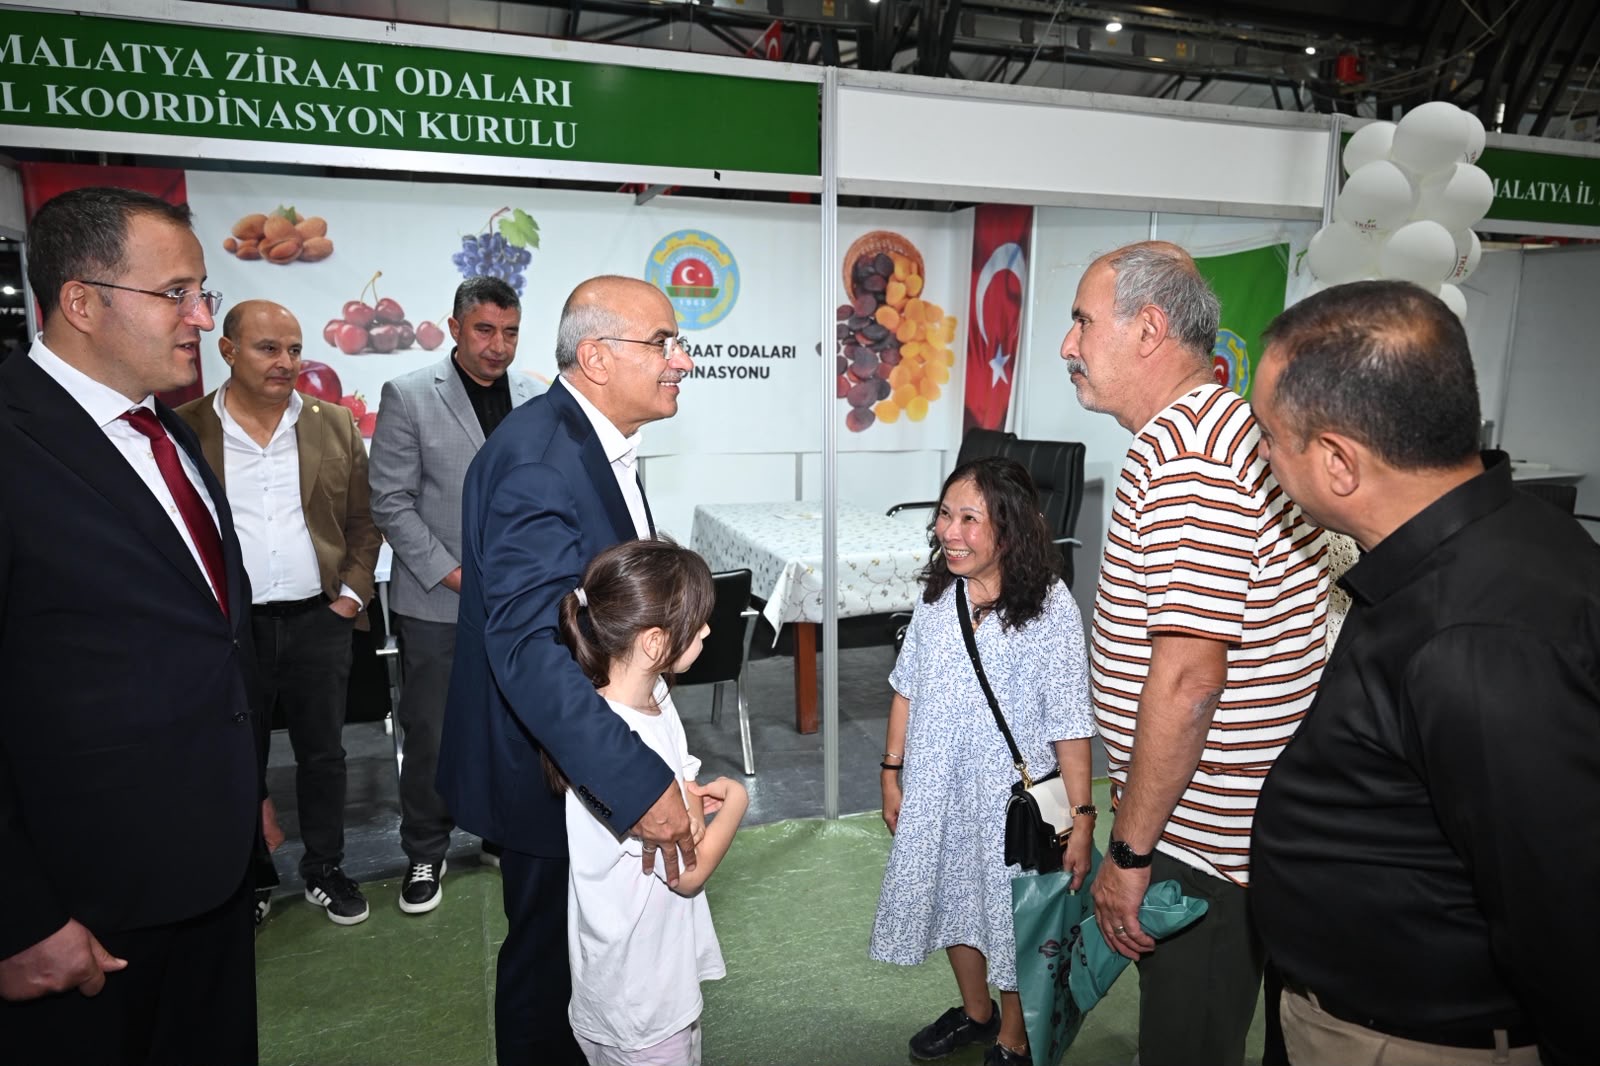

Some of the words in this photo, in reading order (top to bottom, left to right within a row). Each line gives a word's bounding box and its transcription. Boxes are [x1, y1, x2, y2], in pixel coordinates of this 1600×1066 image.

[0, 34, 214, 79] MALATYA
[226, 46, 383, 93] ZİRAAT
[395, 66, 573, 108] ODALARI
[42, 83, 405, 137] KOORDİNASYON
[417, 111, 579, 148] KURULU
[1576, 181, 1595, 206] İL
[727, 344, 796, 359] ODALARI
